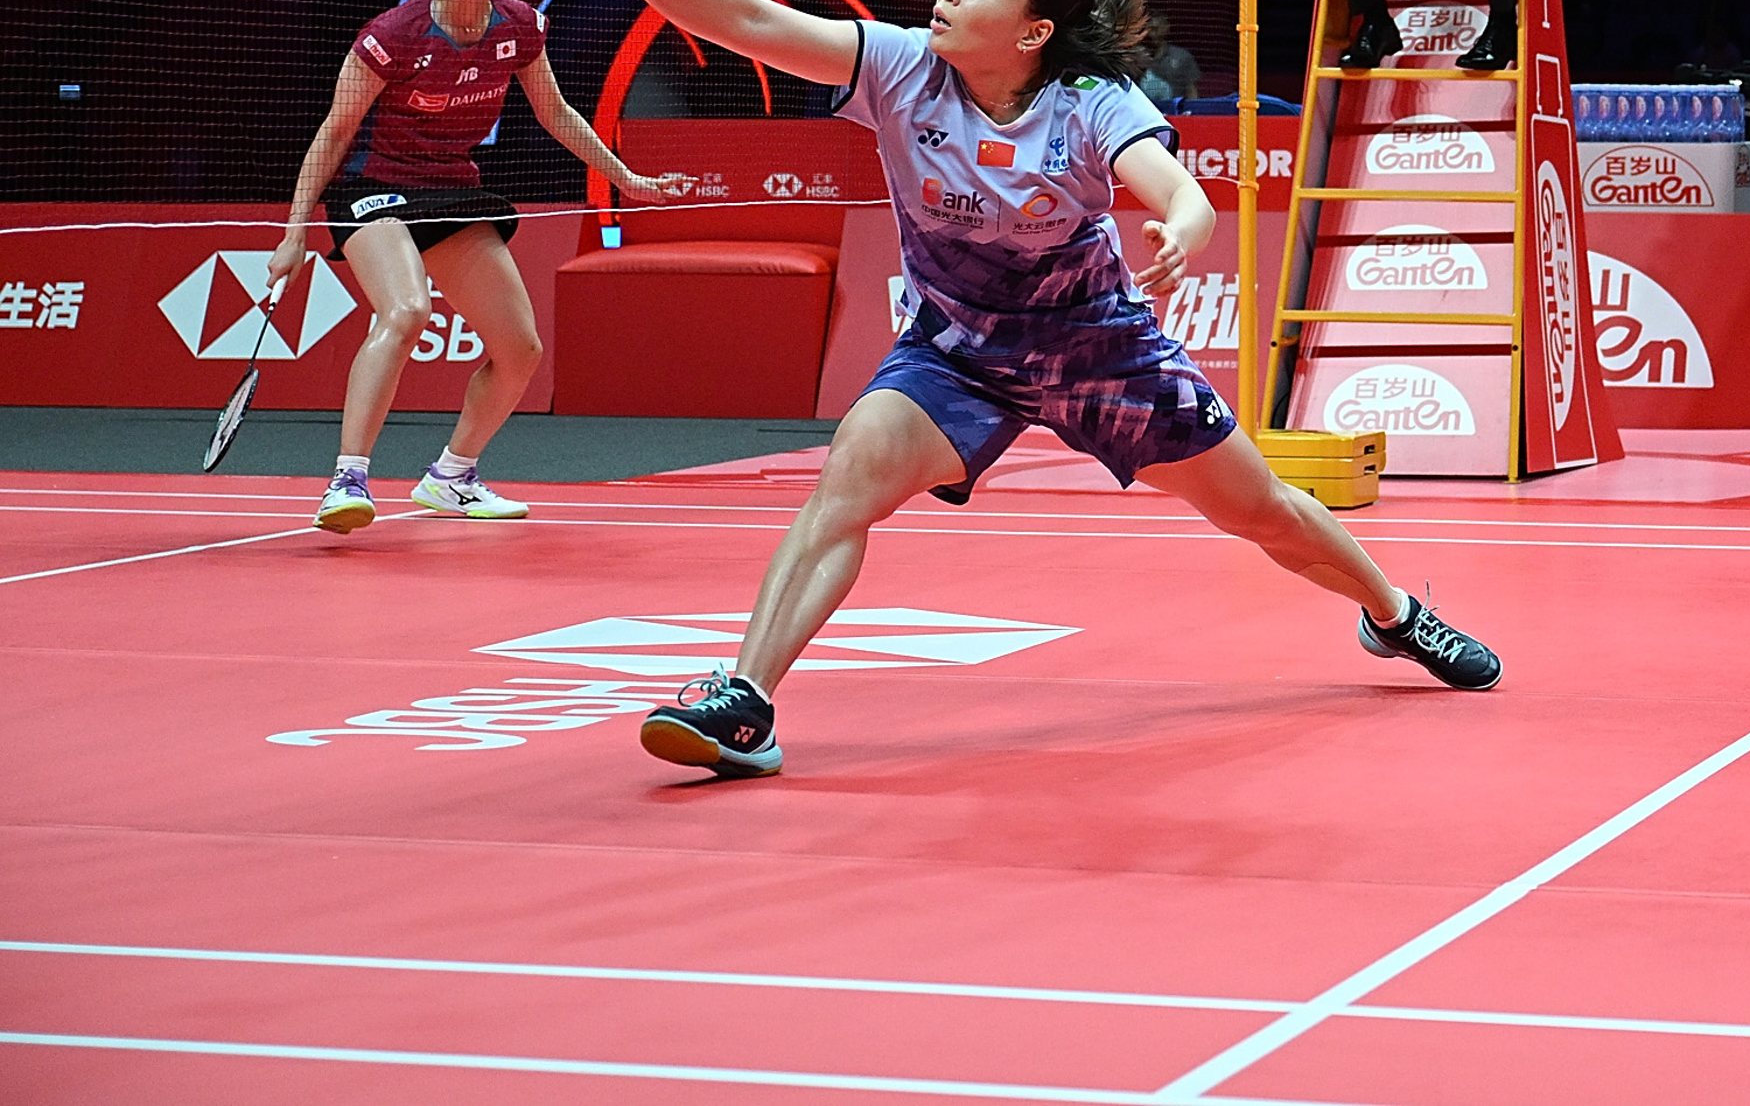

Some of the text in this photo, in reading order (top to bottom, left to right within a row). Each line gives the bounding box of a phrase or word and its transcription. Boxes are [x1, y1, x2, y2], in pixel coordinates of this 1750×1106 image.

[1408, 9, 1474, 28] 百岁山
[1400, 26, 1477, 52] Gante
[450, 83, 509, 106] DAIHATS
[1605, 157, 1677, 176] 百岁山
[1374, 235, 1453, 257] 百岁山
[1355, 377, 1437, 400] 百岁山
